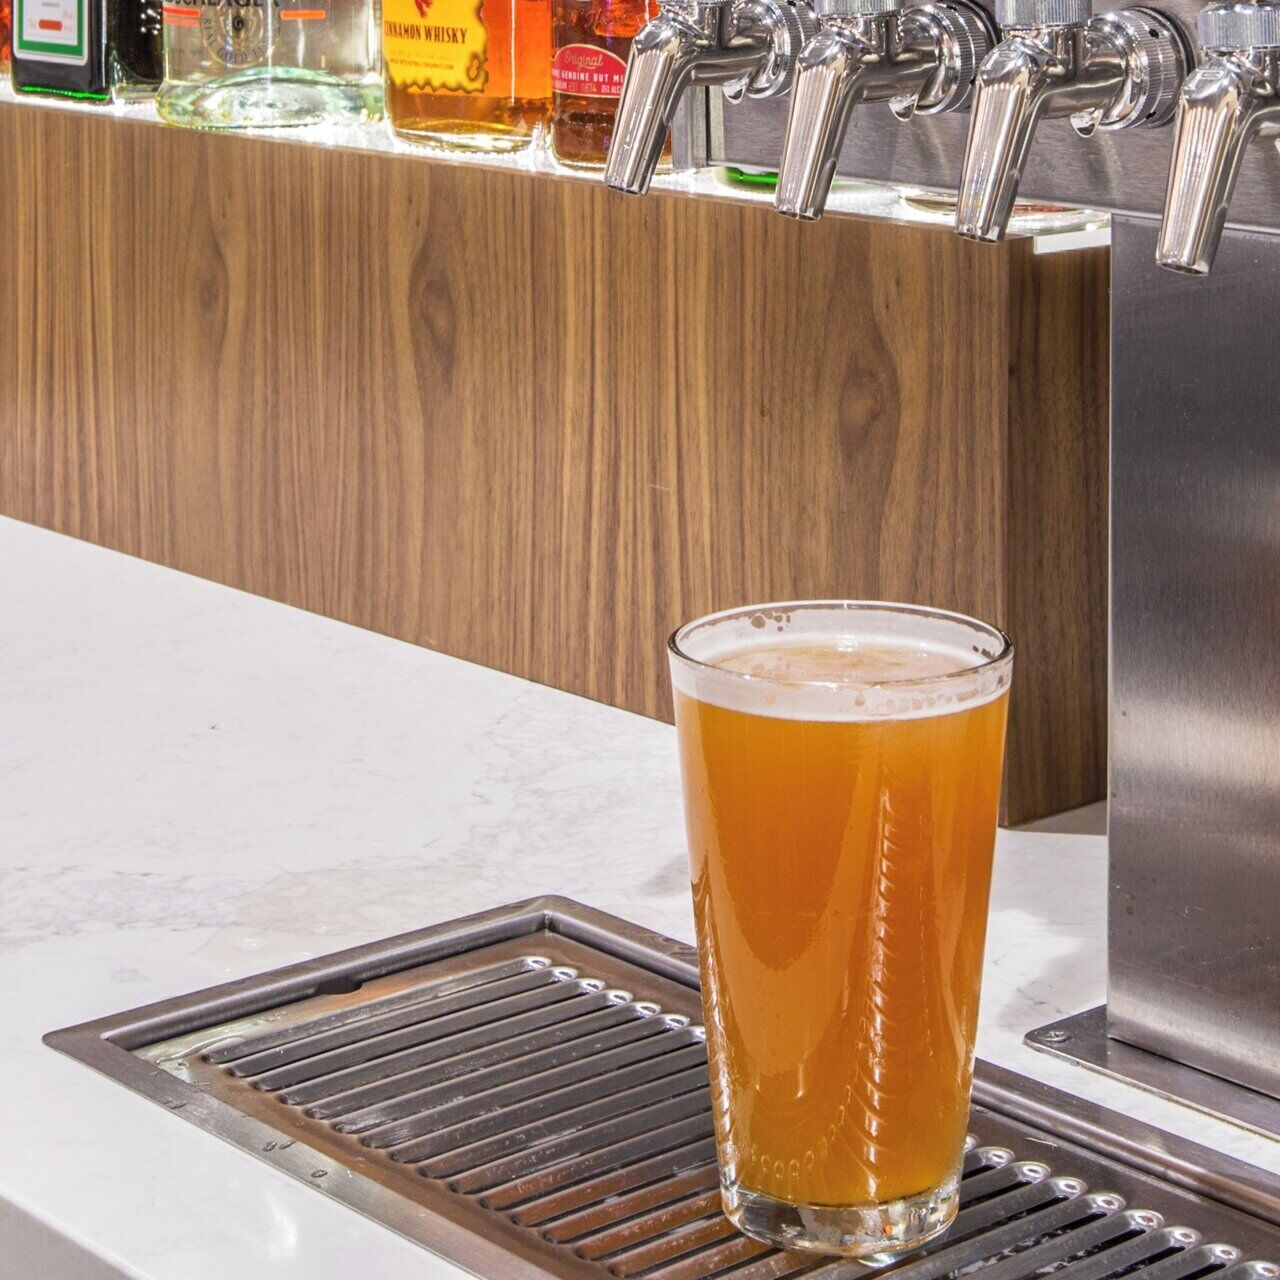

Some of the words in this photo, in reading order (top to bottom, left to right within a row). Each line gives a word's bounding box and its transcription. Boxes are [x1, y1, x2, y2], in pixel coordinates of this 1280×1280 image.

[424, 25, 468, 45] WHISKY
[565, 50, 604, 72] Original
[561, 70, 590, 82] GENUINE
[593, 73, 609, 83] BUT
